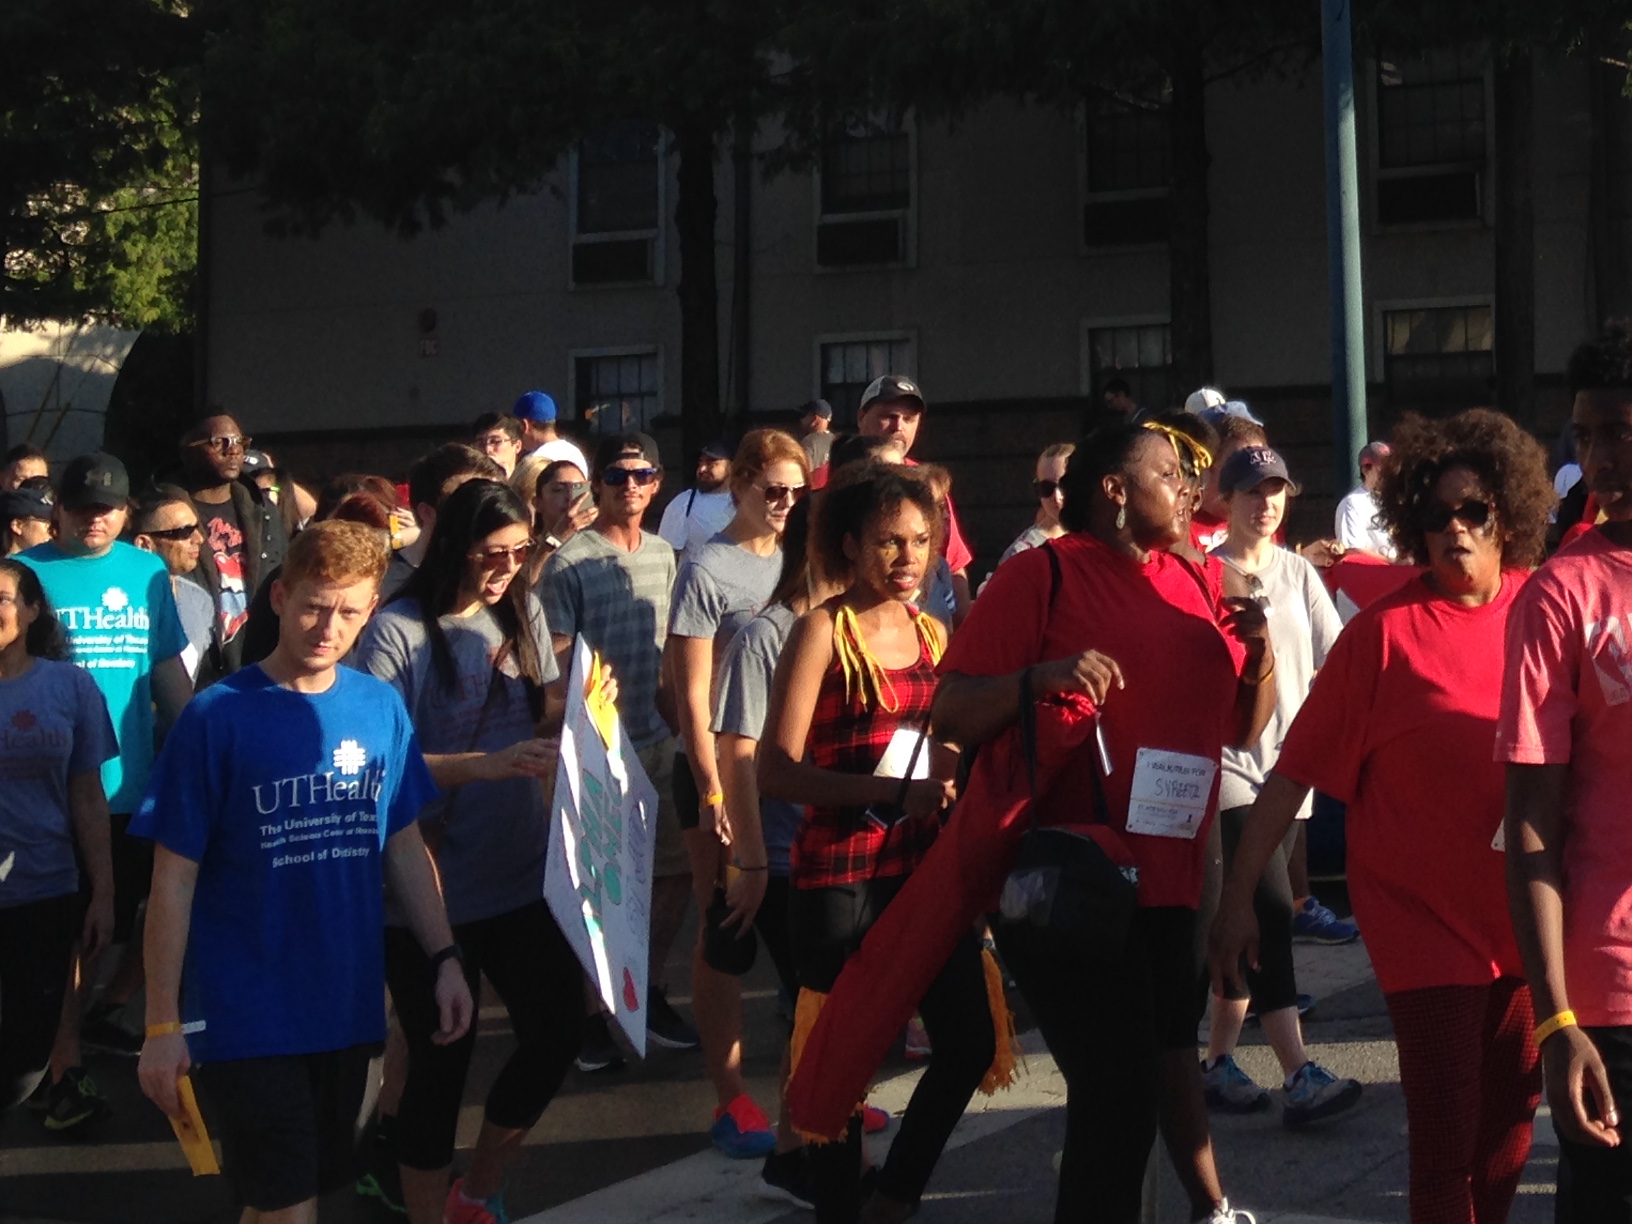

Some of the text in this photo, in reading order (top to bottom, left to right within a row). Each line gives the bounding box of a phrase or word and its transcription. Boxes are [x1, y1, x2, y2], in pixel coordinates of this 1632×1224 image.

[344, 811, 357, 823] of
[359, 811, 378, 822] Tex
[272, 849, 315, 868] School
[317, 849, 328, 860] of
